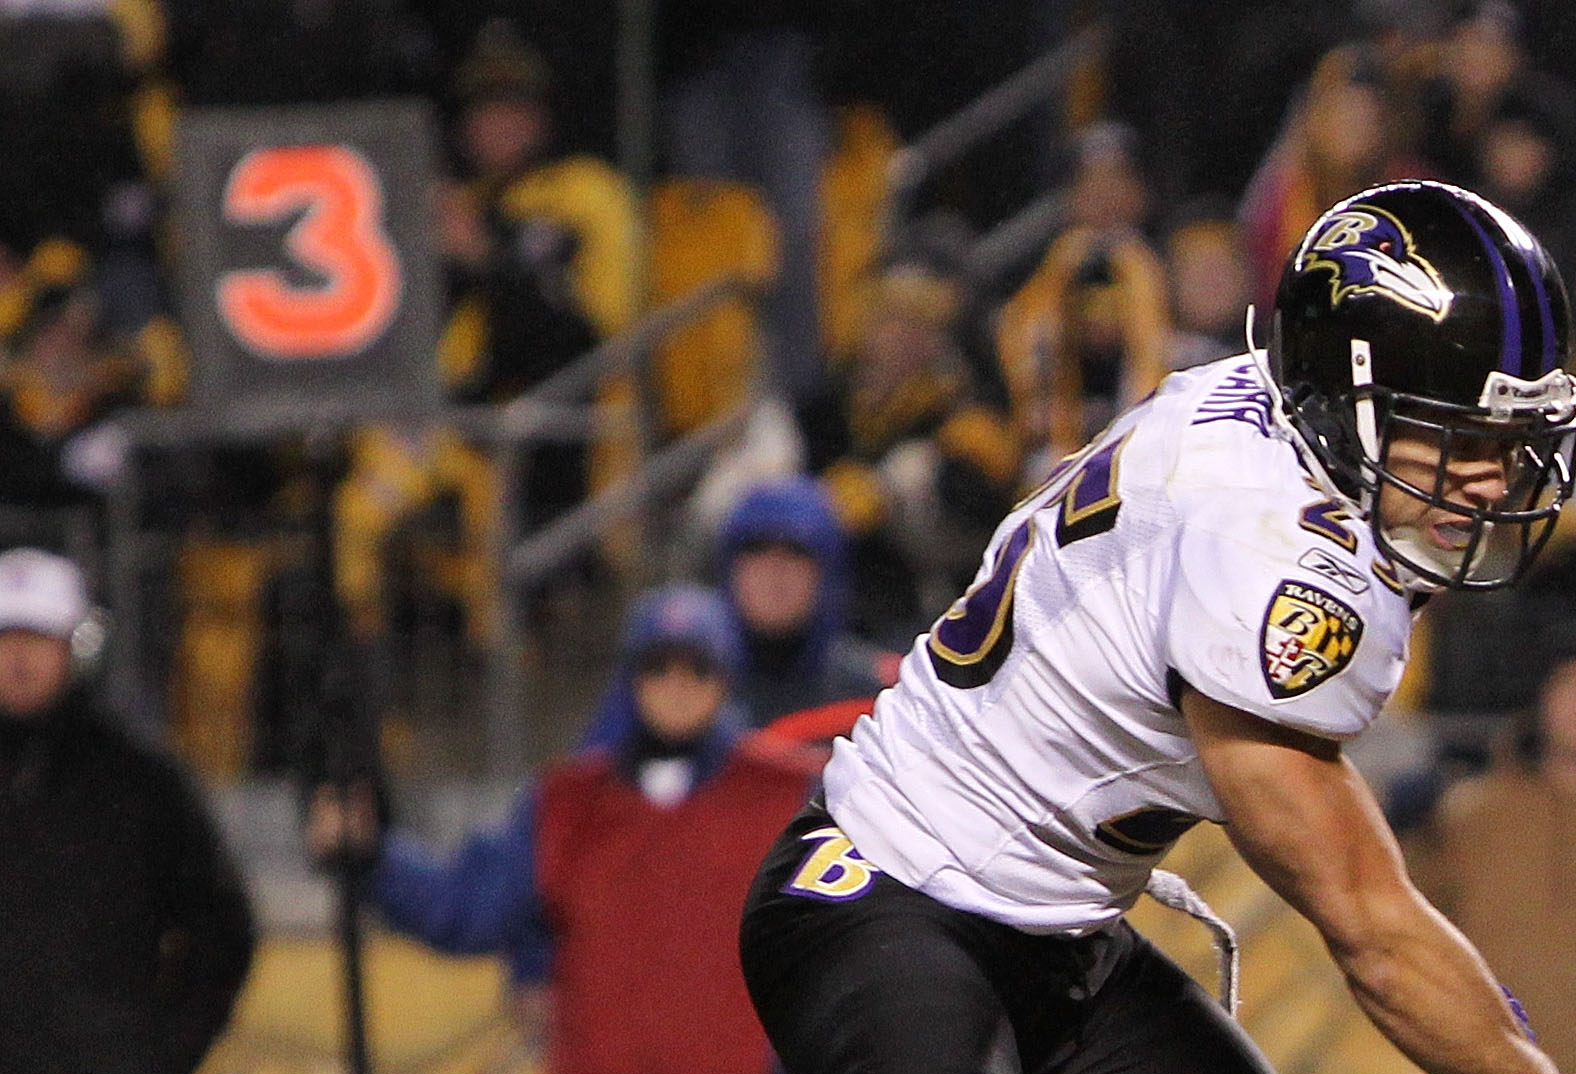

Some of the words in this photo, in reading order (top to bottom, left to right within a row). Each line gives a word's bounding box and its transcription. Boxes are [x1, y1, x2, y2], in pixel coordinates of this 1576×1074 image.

[217, 145, 401, 360] 3
[1313, 211, 1379, 251] B
[785, 825, 880, 900] B
